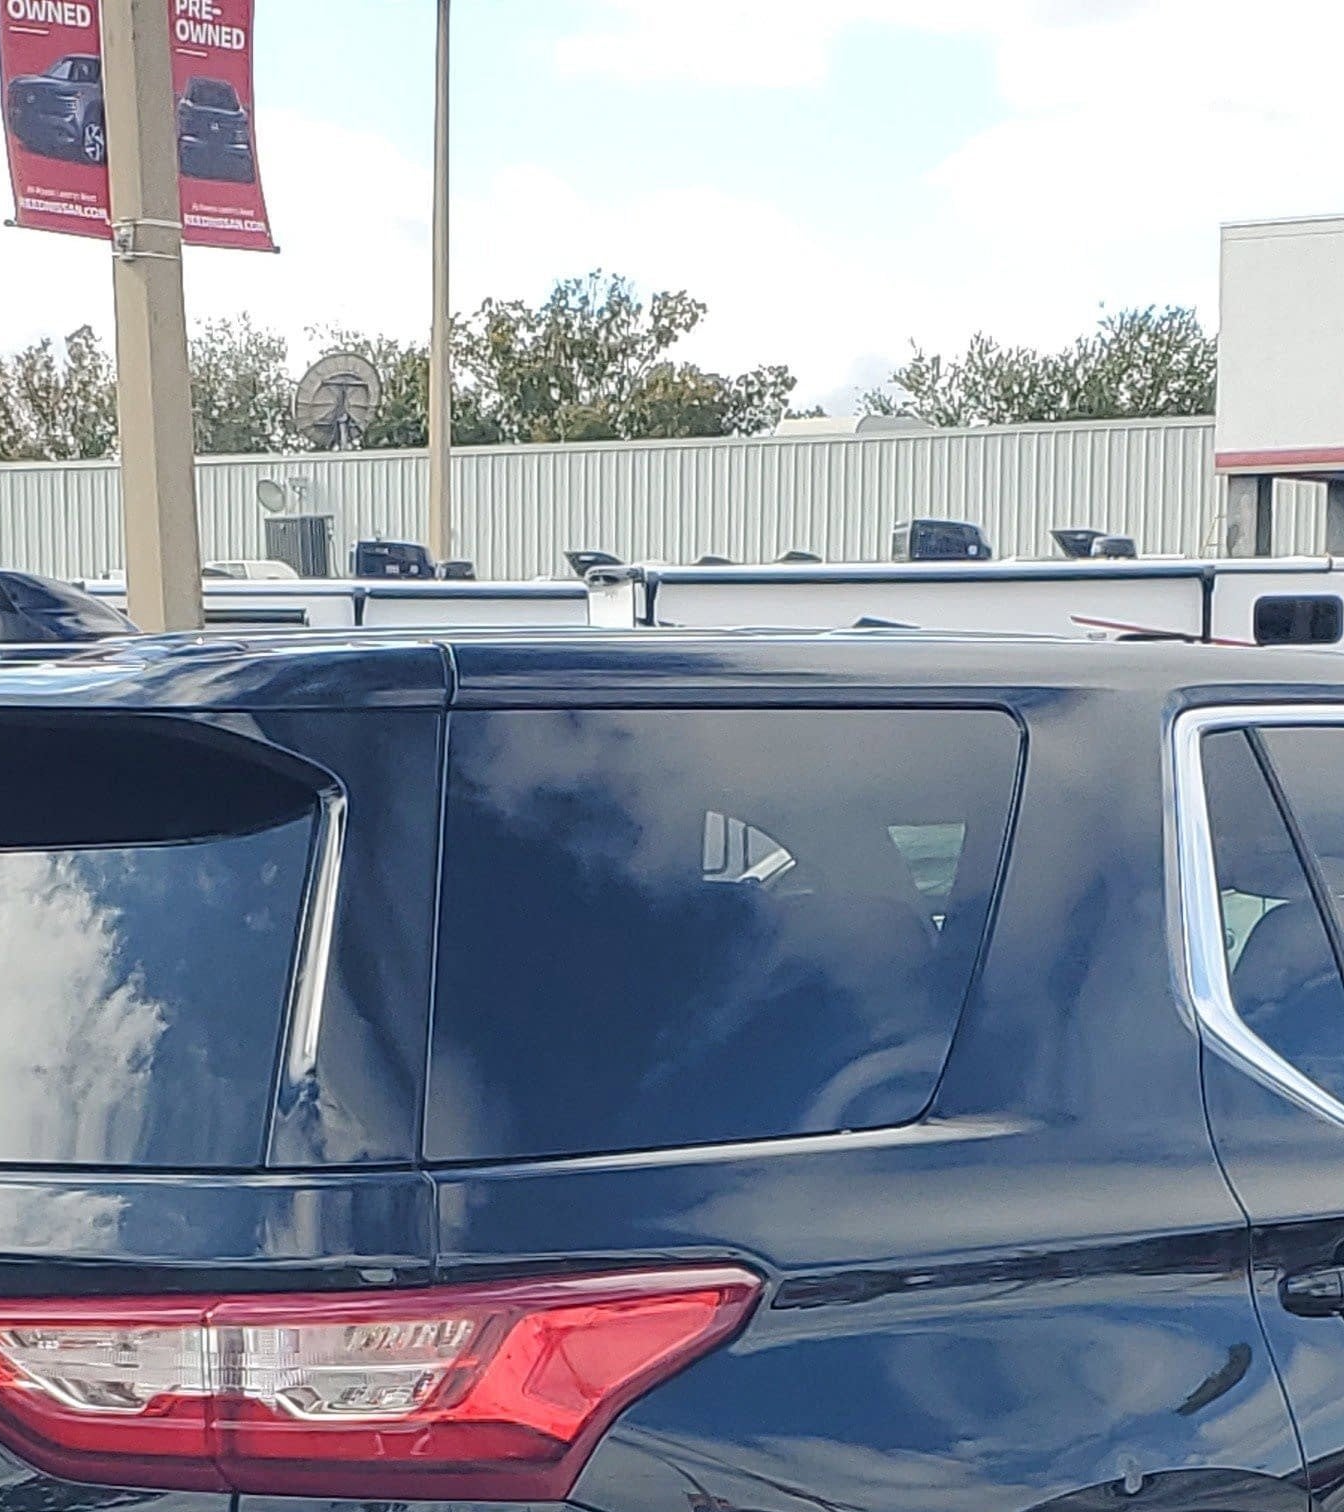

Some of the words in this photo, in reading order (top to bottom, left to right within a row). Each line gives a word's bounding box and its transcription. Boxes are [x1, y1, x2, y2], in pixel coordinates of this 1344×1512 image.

[7, 0, 92, 28] OWNED
[175, 0, 222, 22] PRE-
[175, 19, 246, 50] OWNED
